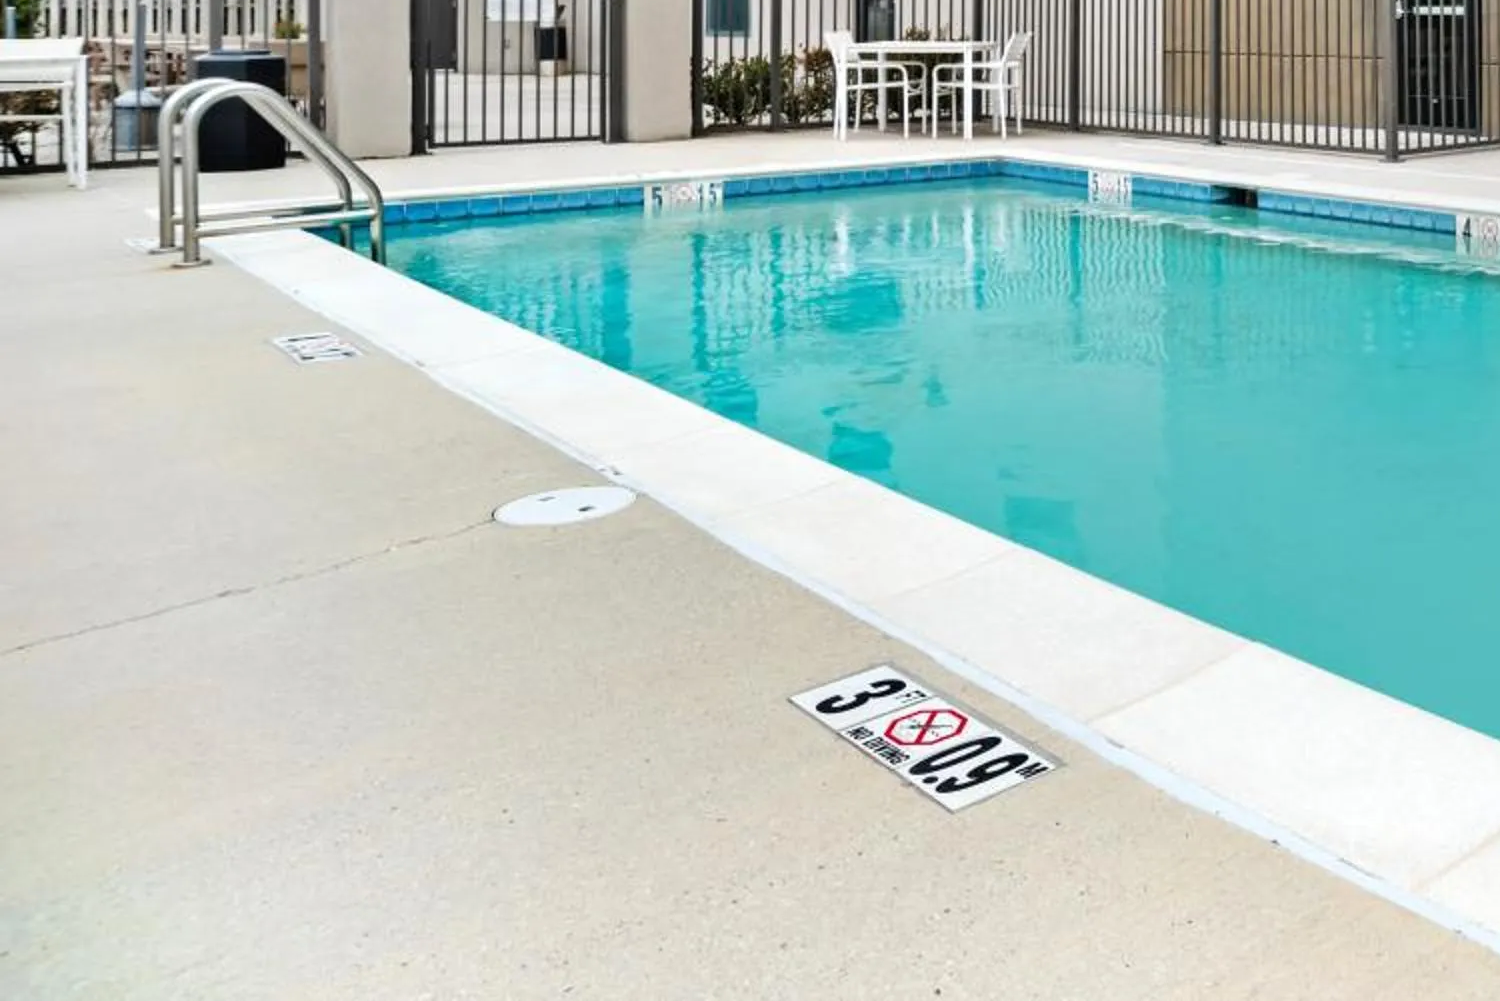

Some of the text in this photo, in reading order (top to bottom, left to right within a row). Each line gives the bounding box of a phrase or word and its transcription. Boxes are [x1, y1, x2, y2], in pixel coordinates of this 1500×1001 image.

[815, 679, 907, 714] 3
[847, 726, 911, 765] NO DIVING
